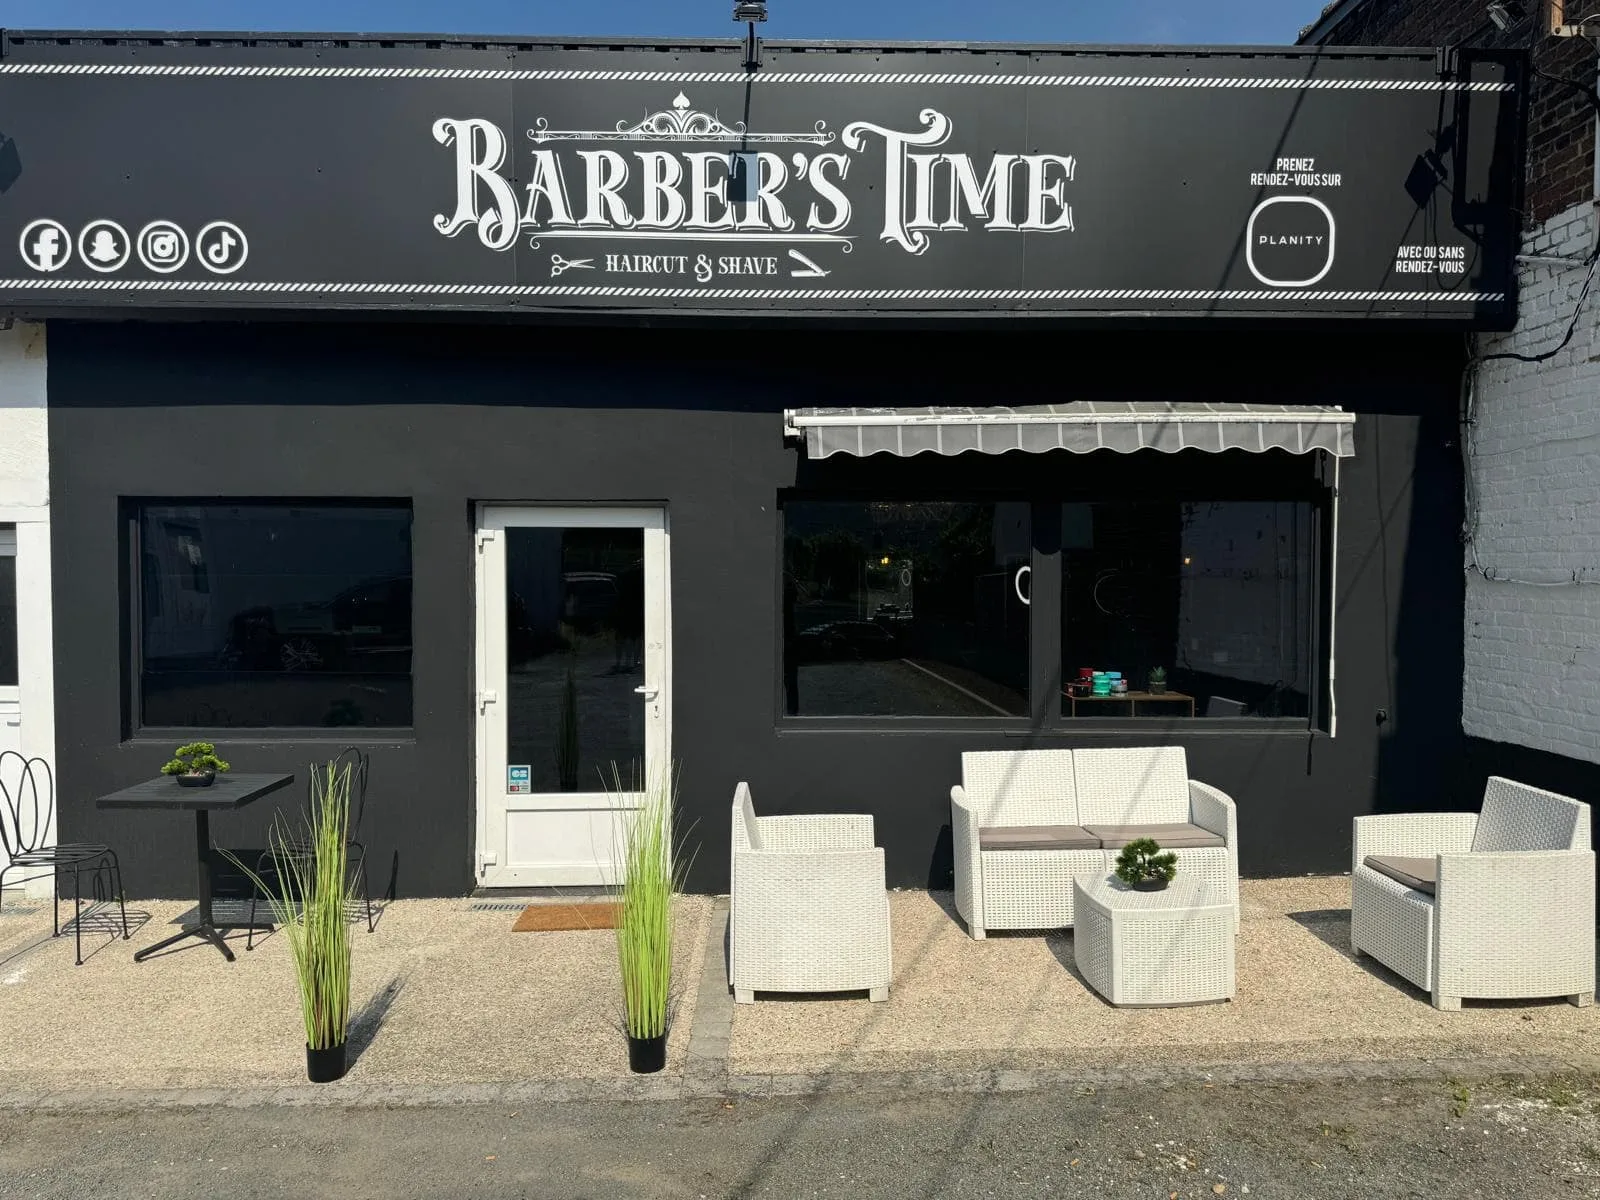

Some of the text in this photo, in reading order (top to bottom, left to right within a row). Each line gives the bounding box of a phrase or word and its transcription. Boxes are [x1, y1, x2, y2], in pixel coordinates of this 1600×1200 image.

[1276, 157, 1315, 172] PRENEZ
[842, 108, 1076, 255] TIME
[1250, 173, 1342, 187] RENDEZ-VOUS SUR
[1259, 235, 1323, 246] PLANITY
[1396, 245, 1465, 260] AVEC OU SANS
[605, 254, 778, 283] HAIRCUT & SHAVE
[1395, 260, 1465, 274] RENDEZ-VOUS
